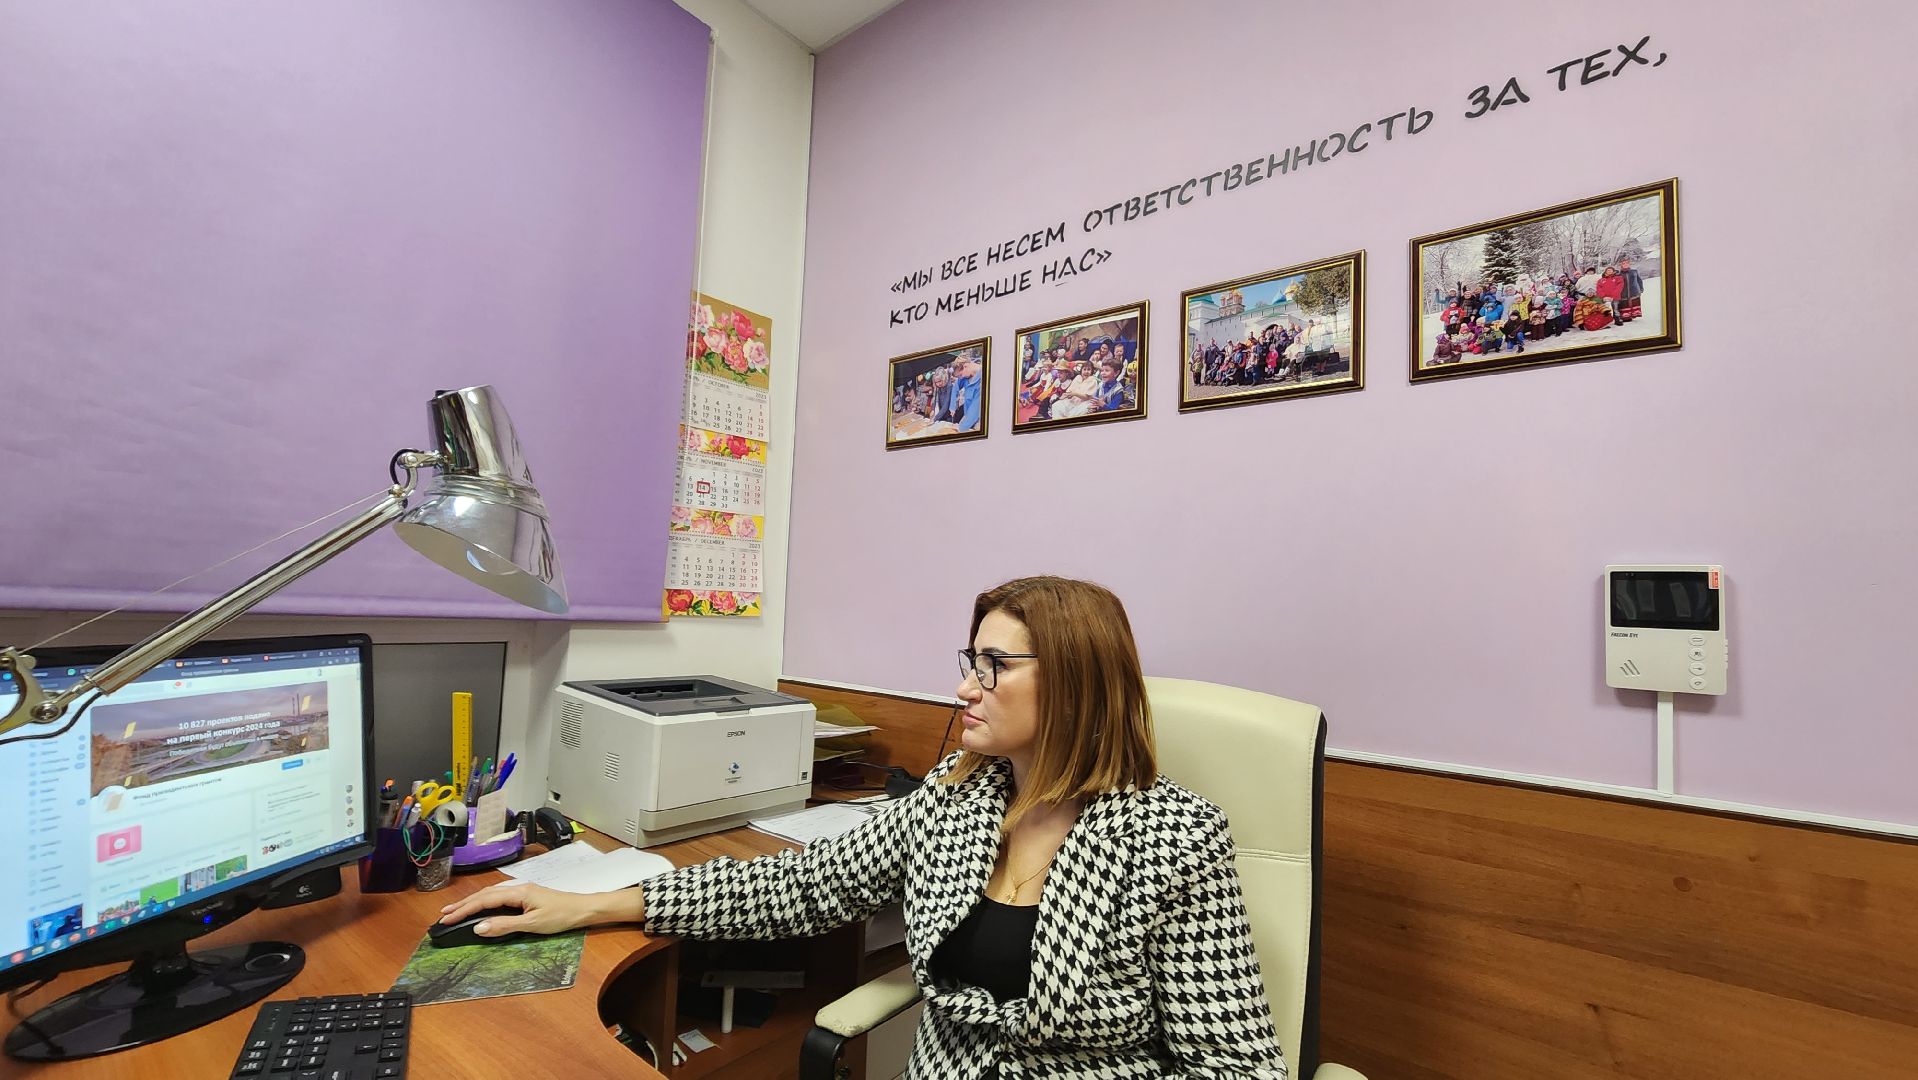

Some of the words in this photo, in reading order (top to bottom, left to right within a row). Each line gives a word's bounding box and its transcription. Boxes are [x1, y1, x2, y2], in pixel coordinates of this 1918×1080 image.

[890, 267, 933, 293] «МЫ
[940, 252, 978, 281] ВСЕ
[987, 222, 1066, 266] НЕСЕМ
[1083, 107, 1434, 233] ОТВЕТСТВЕННОСТЬ
[1464, 76, 1530, 119] ЗА
[1547, 35, 1667, 92] ТЕХ,
[889, 301, 929, 328] КТО
[935, 270, 1032, 316] МЕНЬШЕ
[1042, 247, 1113, 285] НАС»
[179, 722, 189, 730] 10
[190, 719, 206, 729] 827
[179, 730, 212, 743] первый
[213, 727, 246, 738] конкурс
[264, 721, 281, 729] года
[727, 730, 746, 738] EPSON
